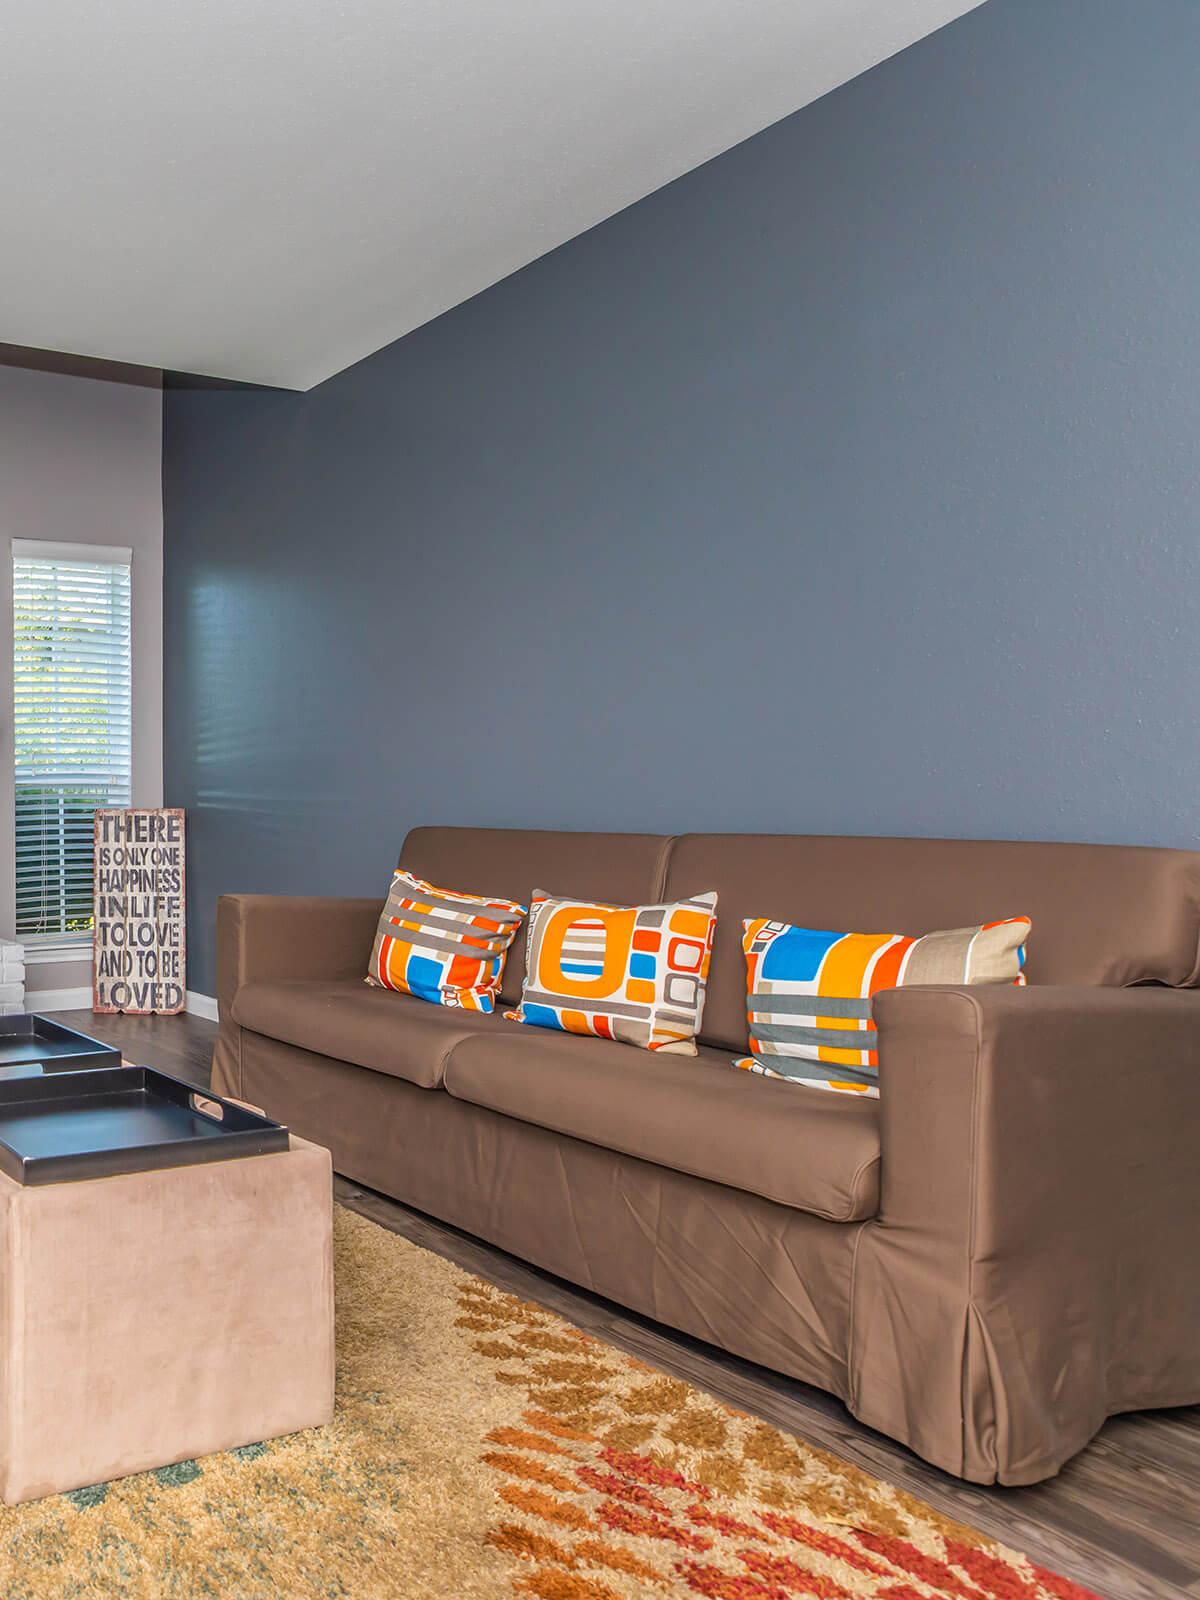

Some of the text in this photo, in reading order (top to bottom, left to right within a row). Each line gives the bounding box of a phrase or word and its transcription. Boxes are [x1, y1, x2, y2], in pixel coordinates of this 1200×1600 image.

[99, 815, 180, 842] THERE
[99, 847, 179, 866] IS ONLY ONE
[99, 868, 180, 893] HAPPINESS
[100, 895, 180, 918] IN LIFE
[99, 922, 179, 947] TO LOVE
[99, 950, 179, 978] AND TO BE
[99, 981, 182, 1009] LOVED
